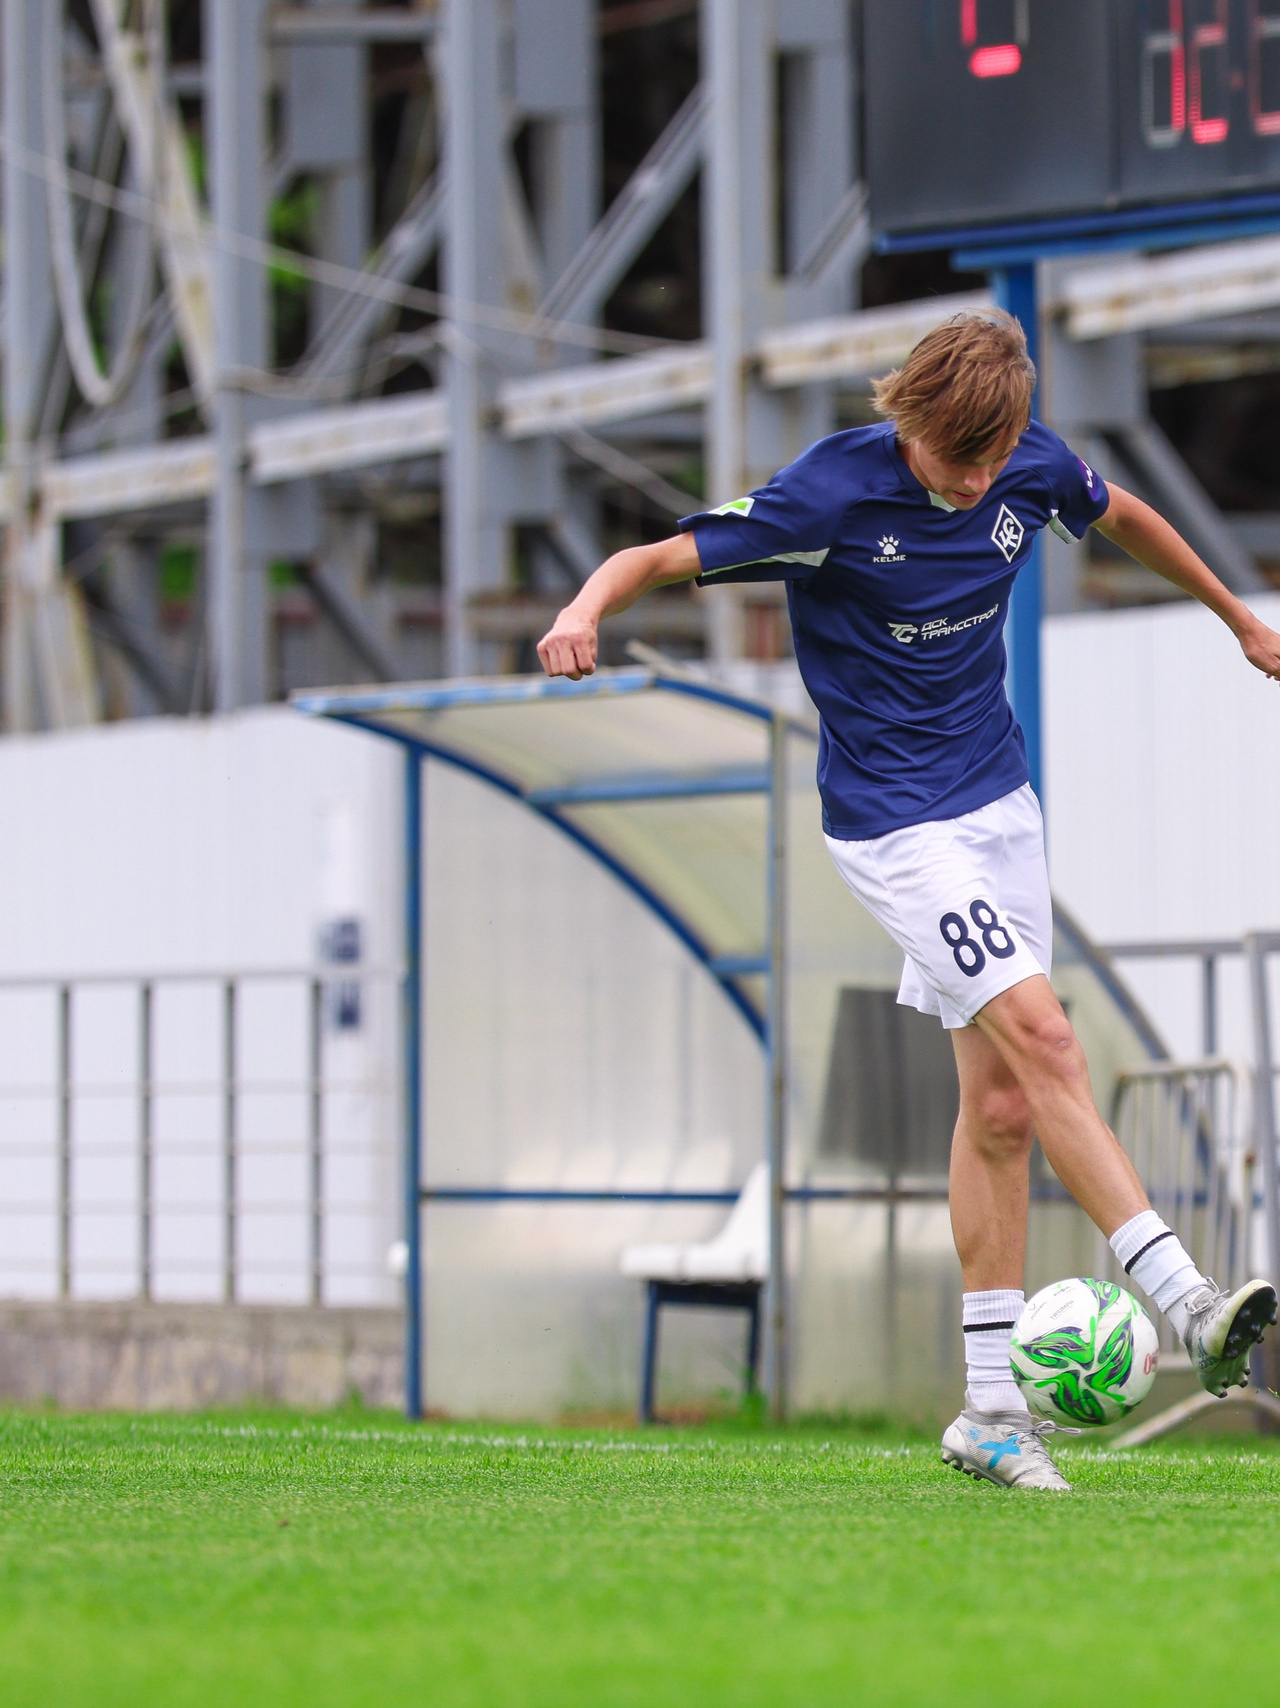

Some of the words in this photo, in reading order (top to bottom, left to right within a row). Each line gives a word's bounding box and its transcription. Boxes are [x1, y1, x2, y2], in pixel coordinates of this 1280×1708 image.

[873, 554, 906, 563] KELME
[921, 617, 949, 632] ДСК
[939, 899, 1017, 977] 88
[1050, 1300, 1074, 1320] TRIUMPH
